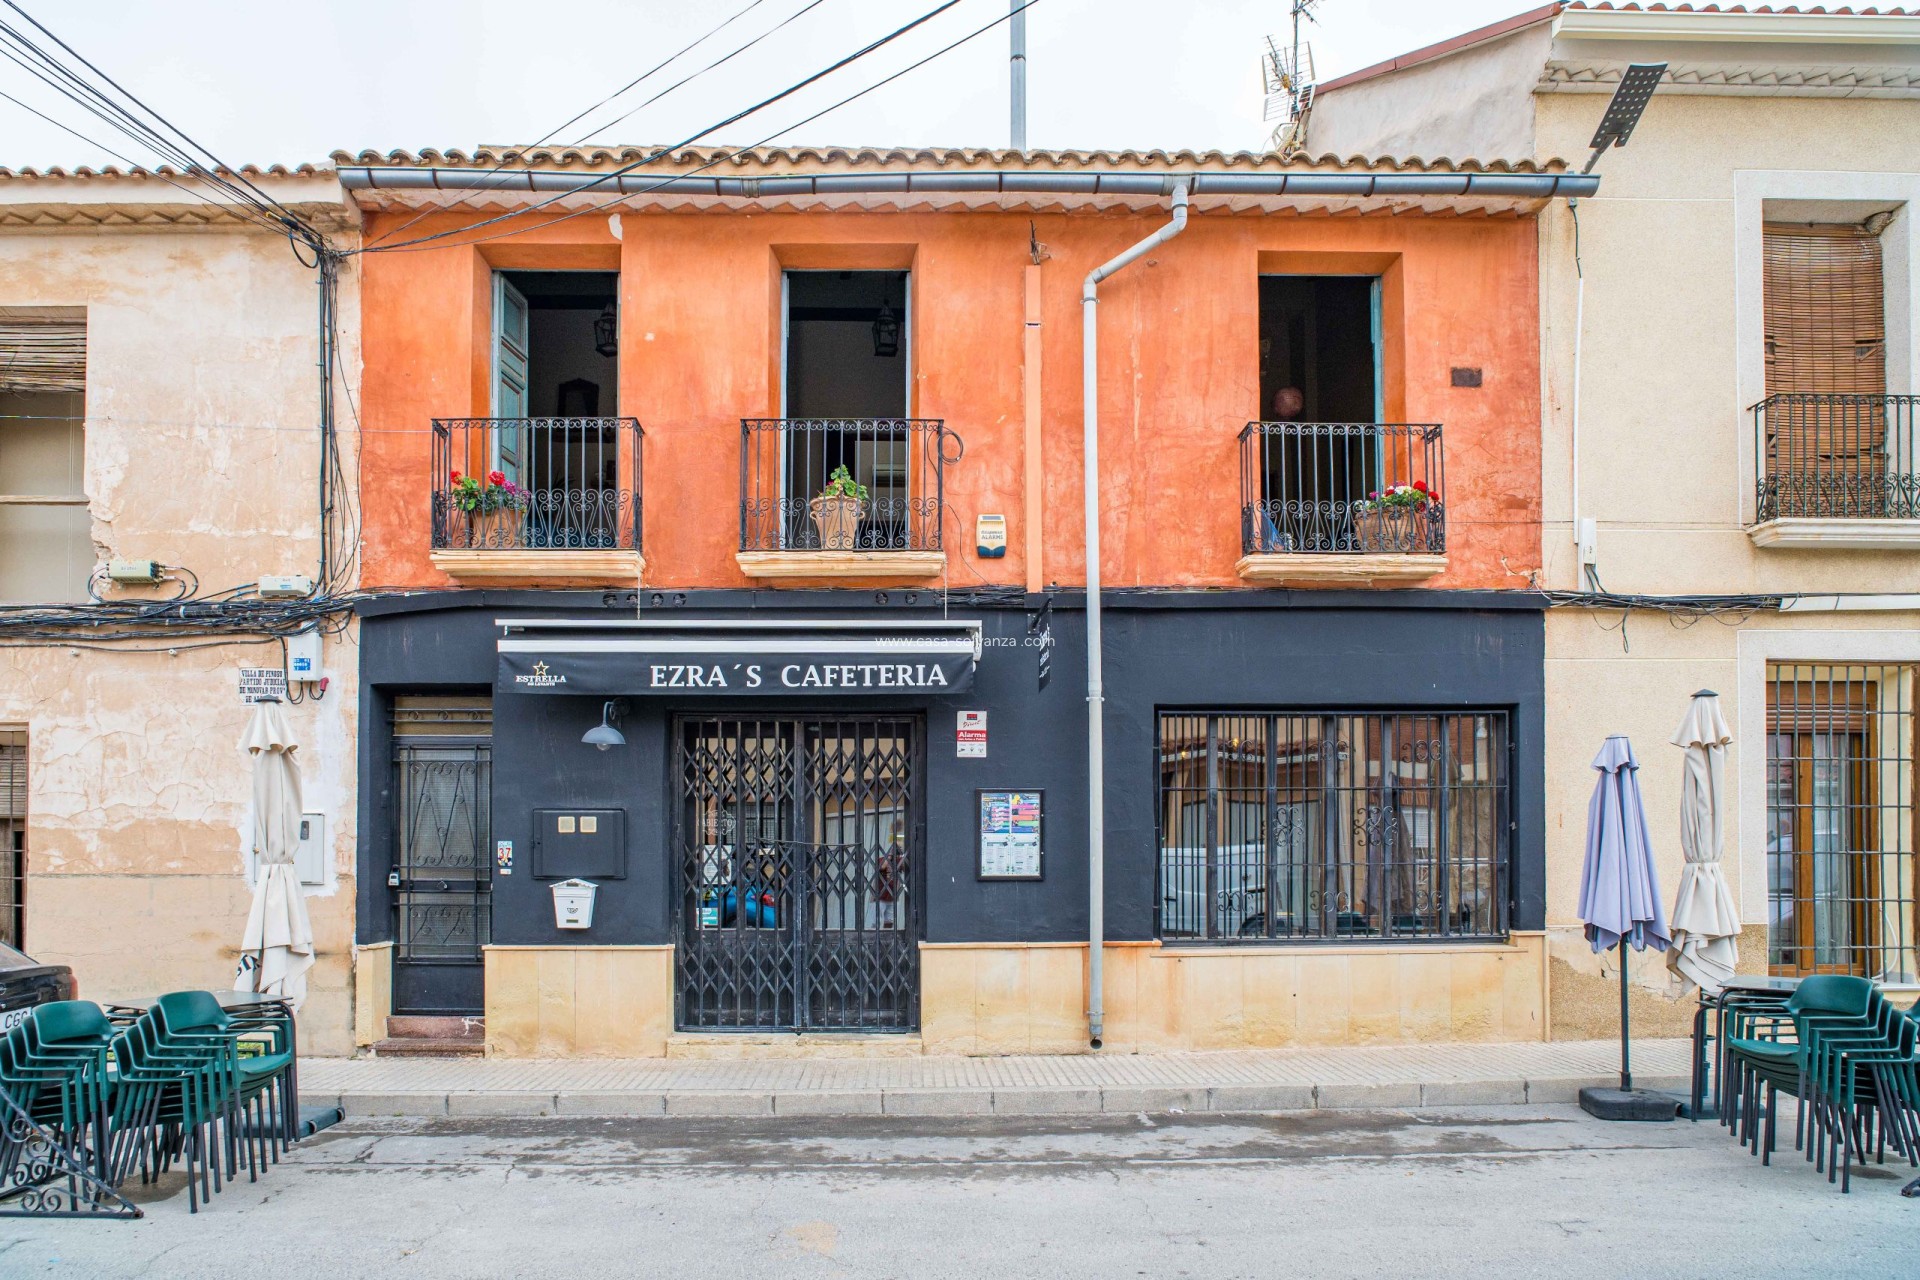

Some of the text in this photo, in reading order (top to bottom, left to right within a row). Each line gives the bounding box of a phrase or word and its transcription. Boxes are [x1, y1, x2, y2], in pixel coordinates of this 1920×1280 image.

[515, 675, 567, 683] ESTRELLA
[781, 664, 948, 687] CAFETERIA
[499, 848, 511, 859] 37
